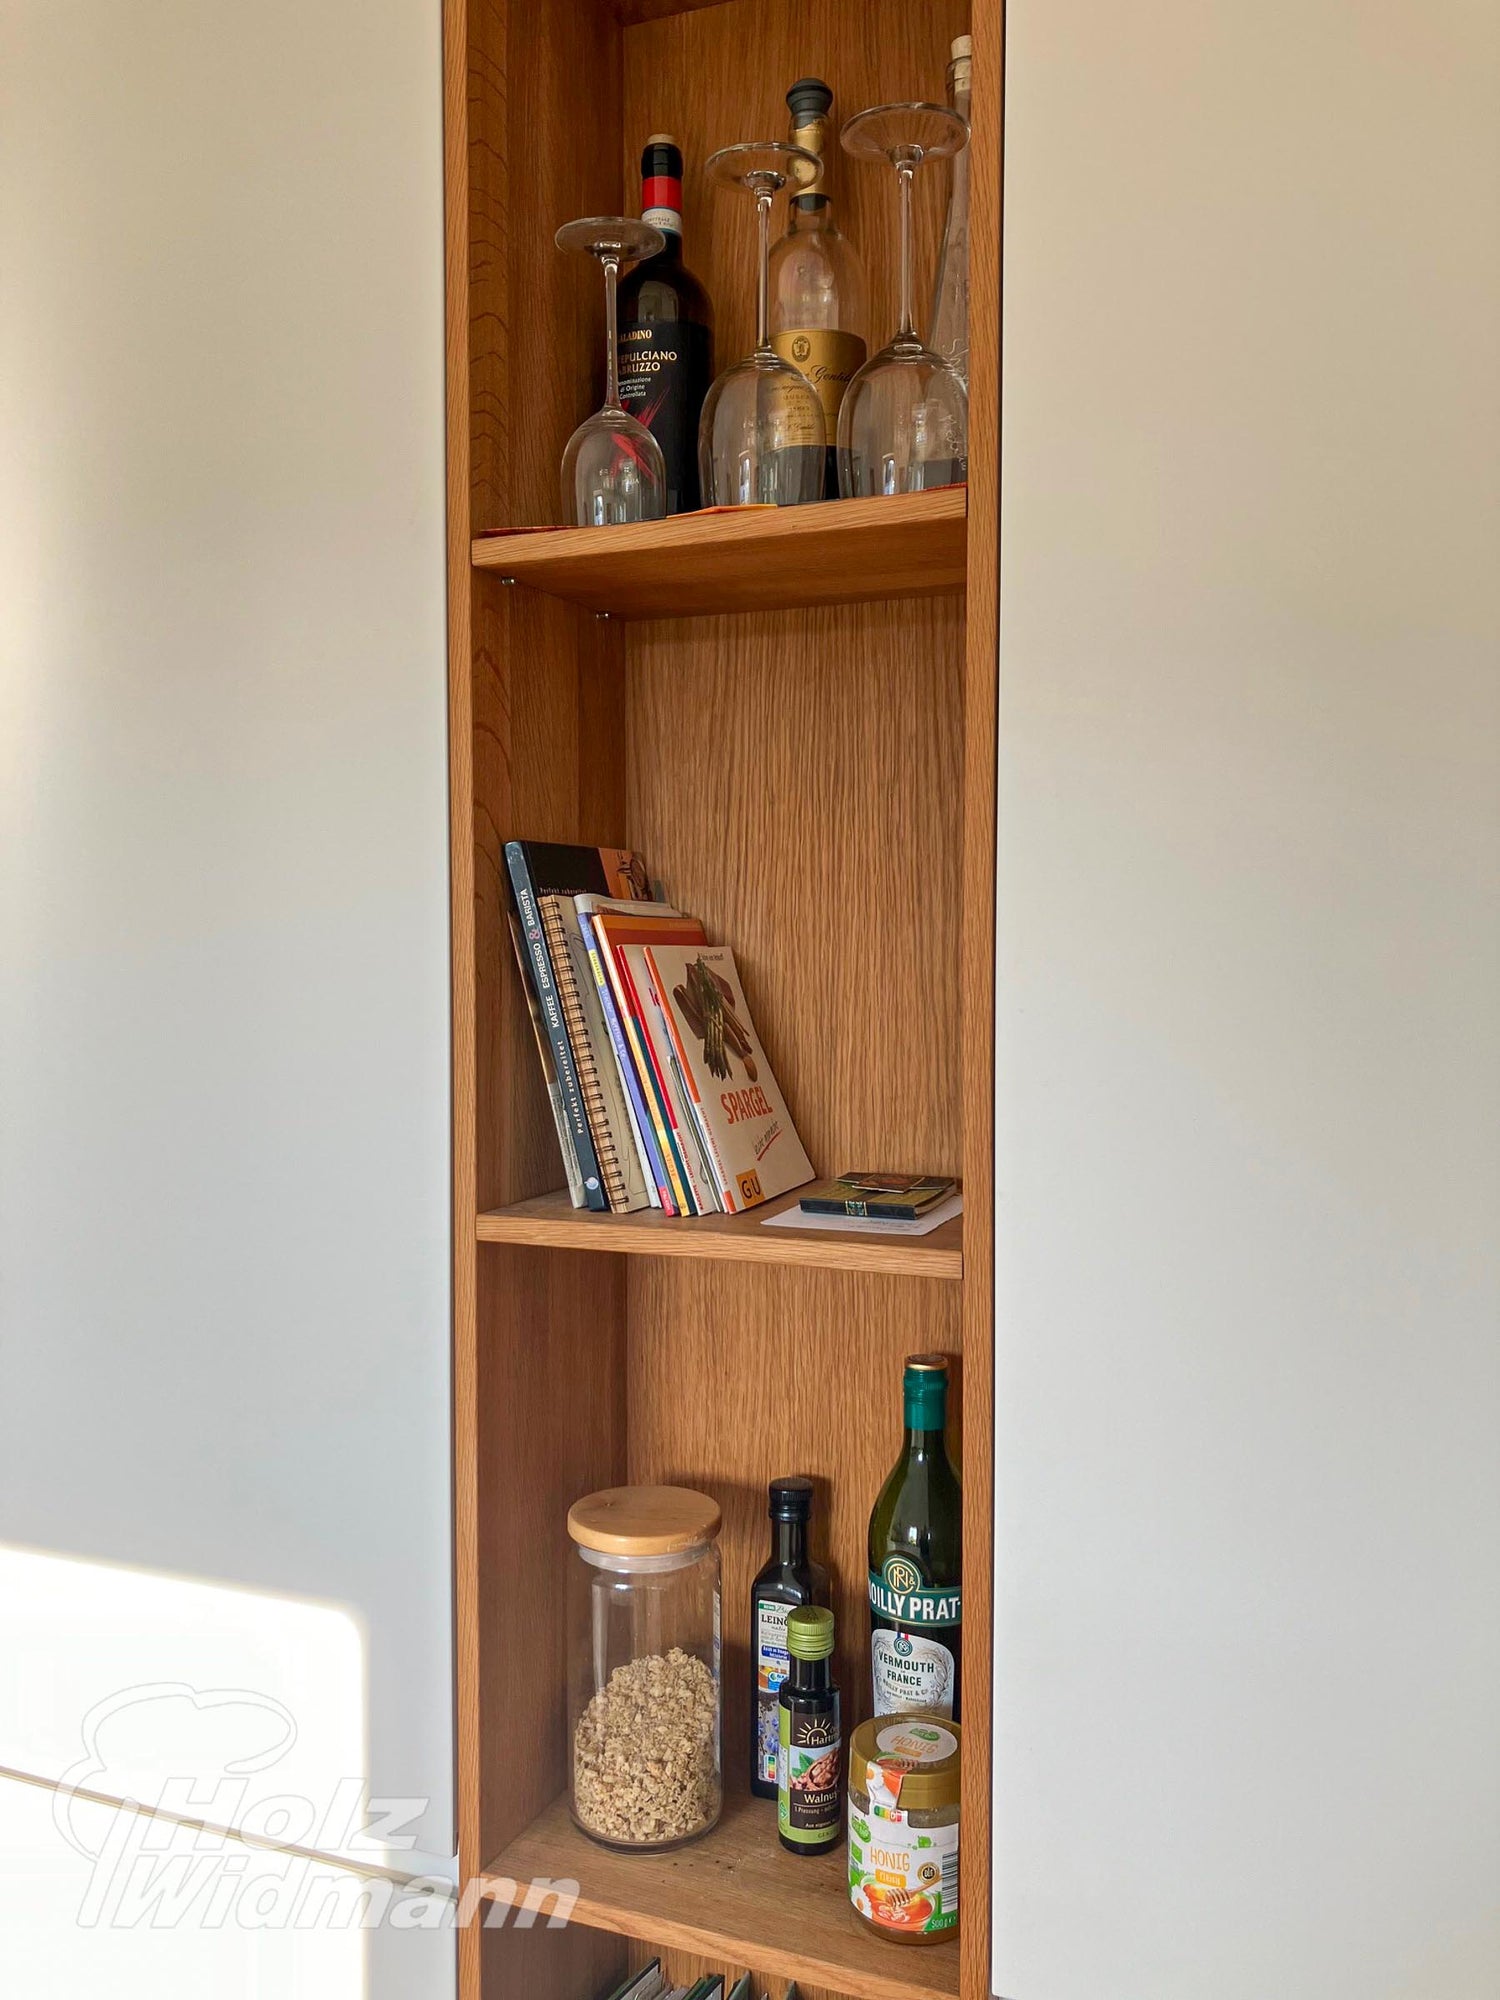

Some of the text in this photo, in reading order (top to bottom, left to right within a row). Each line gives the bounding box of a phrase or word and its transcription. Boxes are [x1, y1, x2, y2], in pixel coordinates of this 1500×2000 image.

[626, 384, 646, 392] Origine
[520, 888, 559, 1027] KAFFEE ESPRESSO & BARISTA
[557, 1040, 573, 1092] zubereitet
[570, 1096, 582, 1133] Perfekt
[720, 1086, 774, 1124] SPARGEL
[742, 1176, 760, 1199] GU
[878, 1650, 934, 1673] VERMOUTH
[887, 1670, 922, 1686] FRANCE
[890, 1735, 938, 1754] HONIG
[870, 1847, 910, 1872] HONIG
